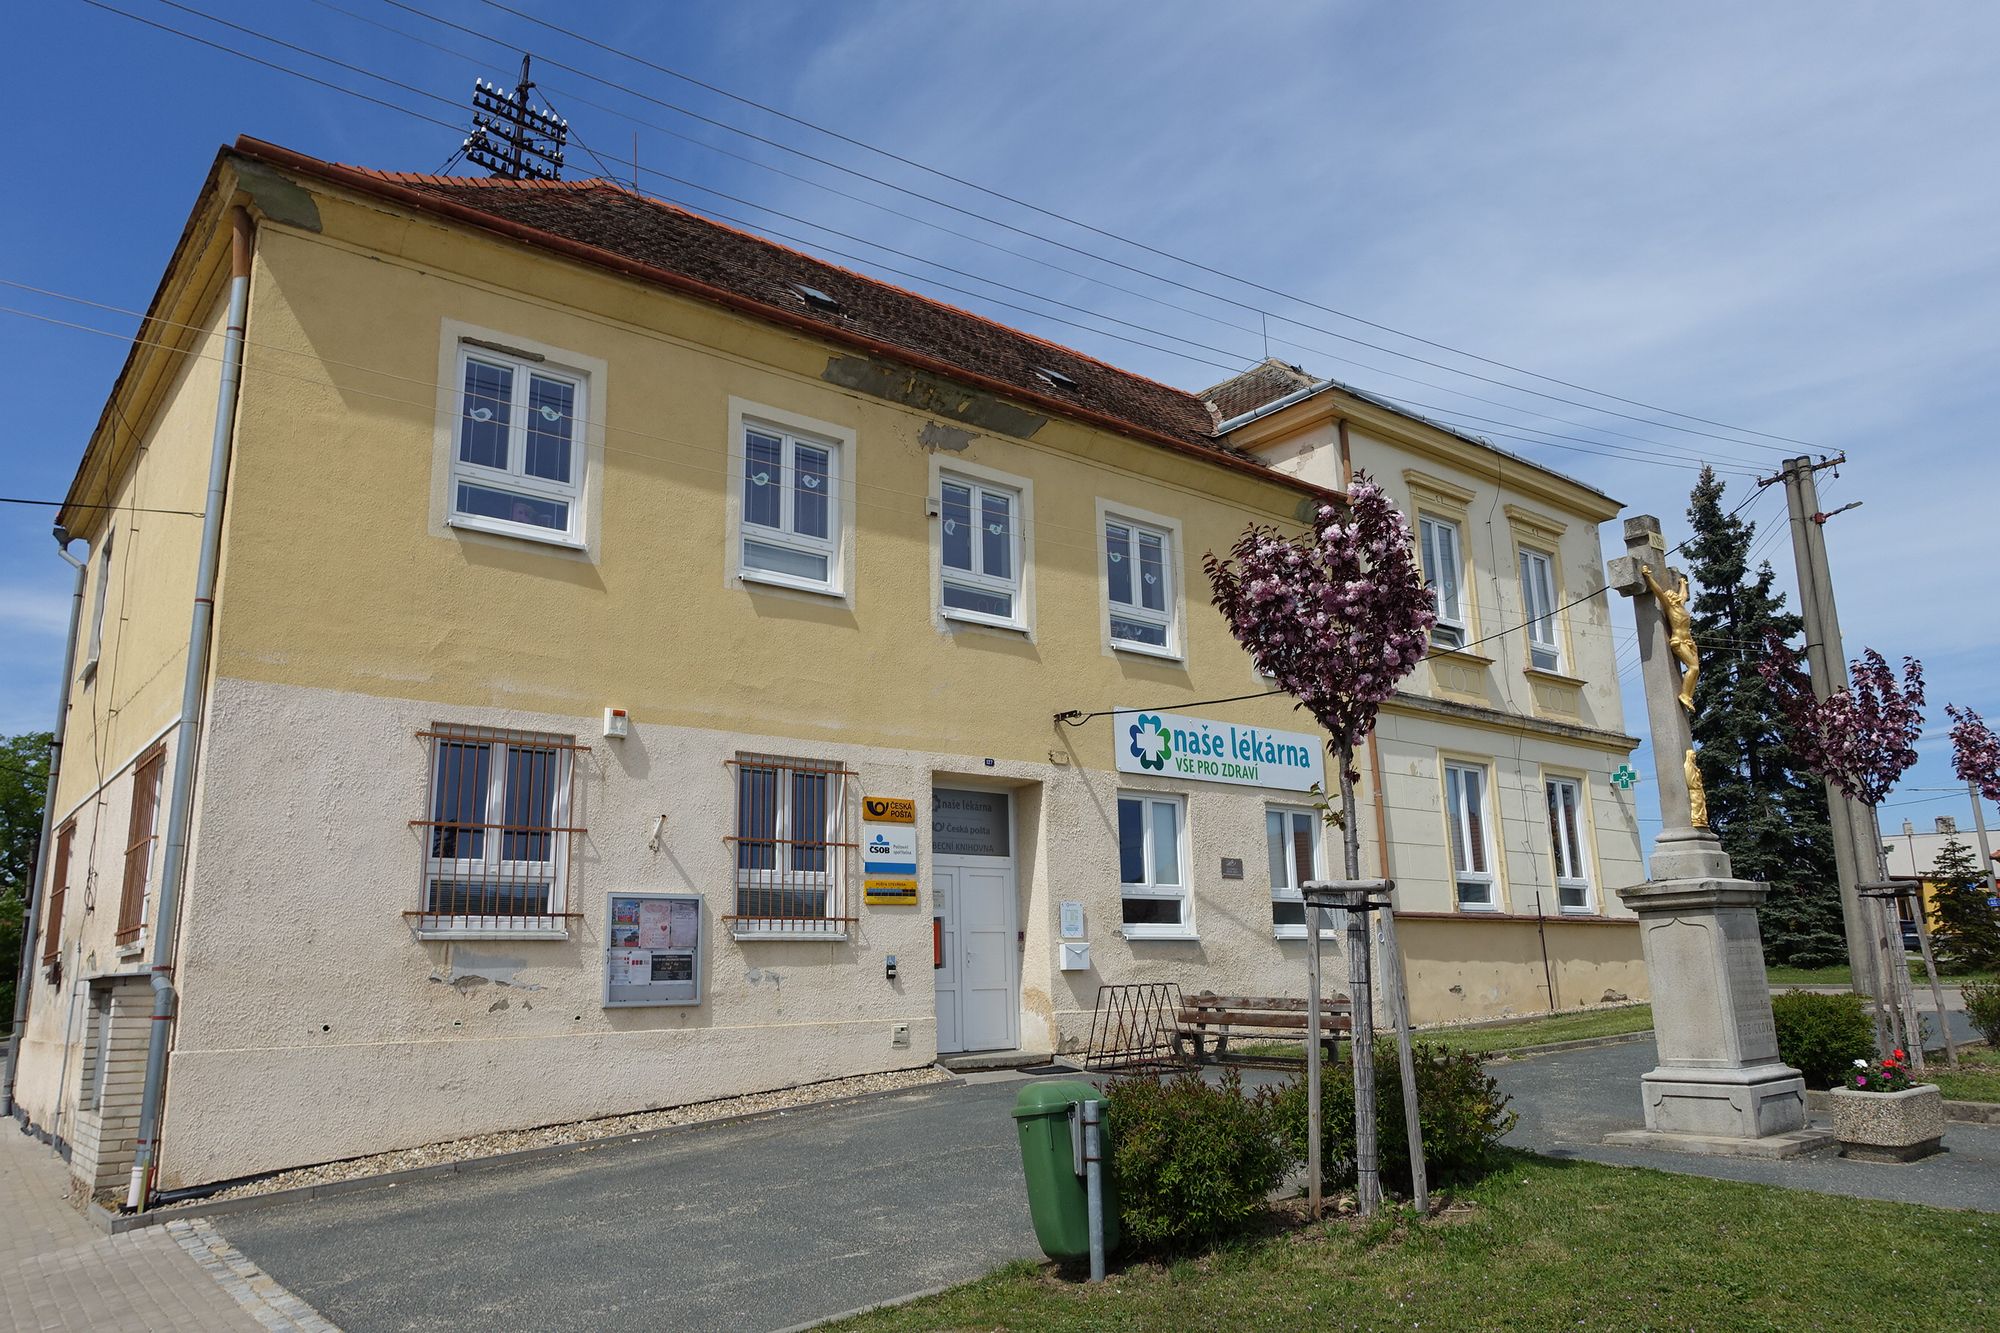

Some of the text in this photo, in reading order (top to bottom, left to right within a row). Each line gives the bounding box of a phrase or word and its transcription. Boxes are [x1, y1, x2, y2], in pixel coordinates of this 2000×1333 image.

[1173, 725, 1311, 768] naše lékárna
[1175, 754, 1259, 780] VŠE PRO ZDRAVÍ
[890, 801, 912, 810] ČESKÁ
[942, 799, 992, 812] naše lékárna
[890, 810, 912, 818] POŠTA
[946, 822, 991, 835] Česká pošta
[869, 845, 890, 854] ČSOB
[932, 841, 994, 853] BECNÍ KNIHOVNA
